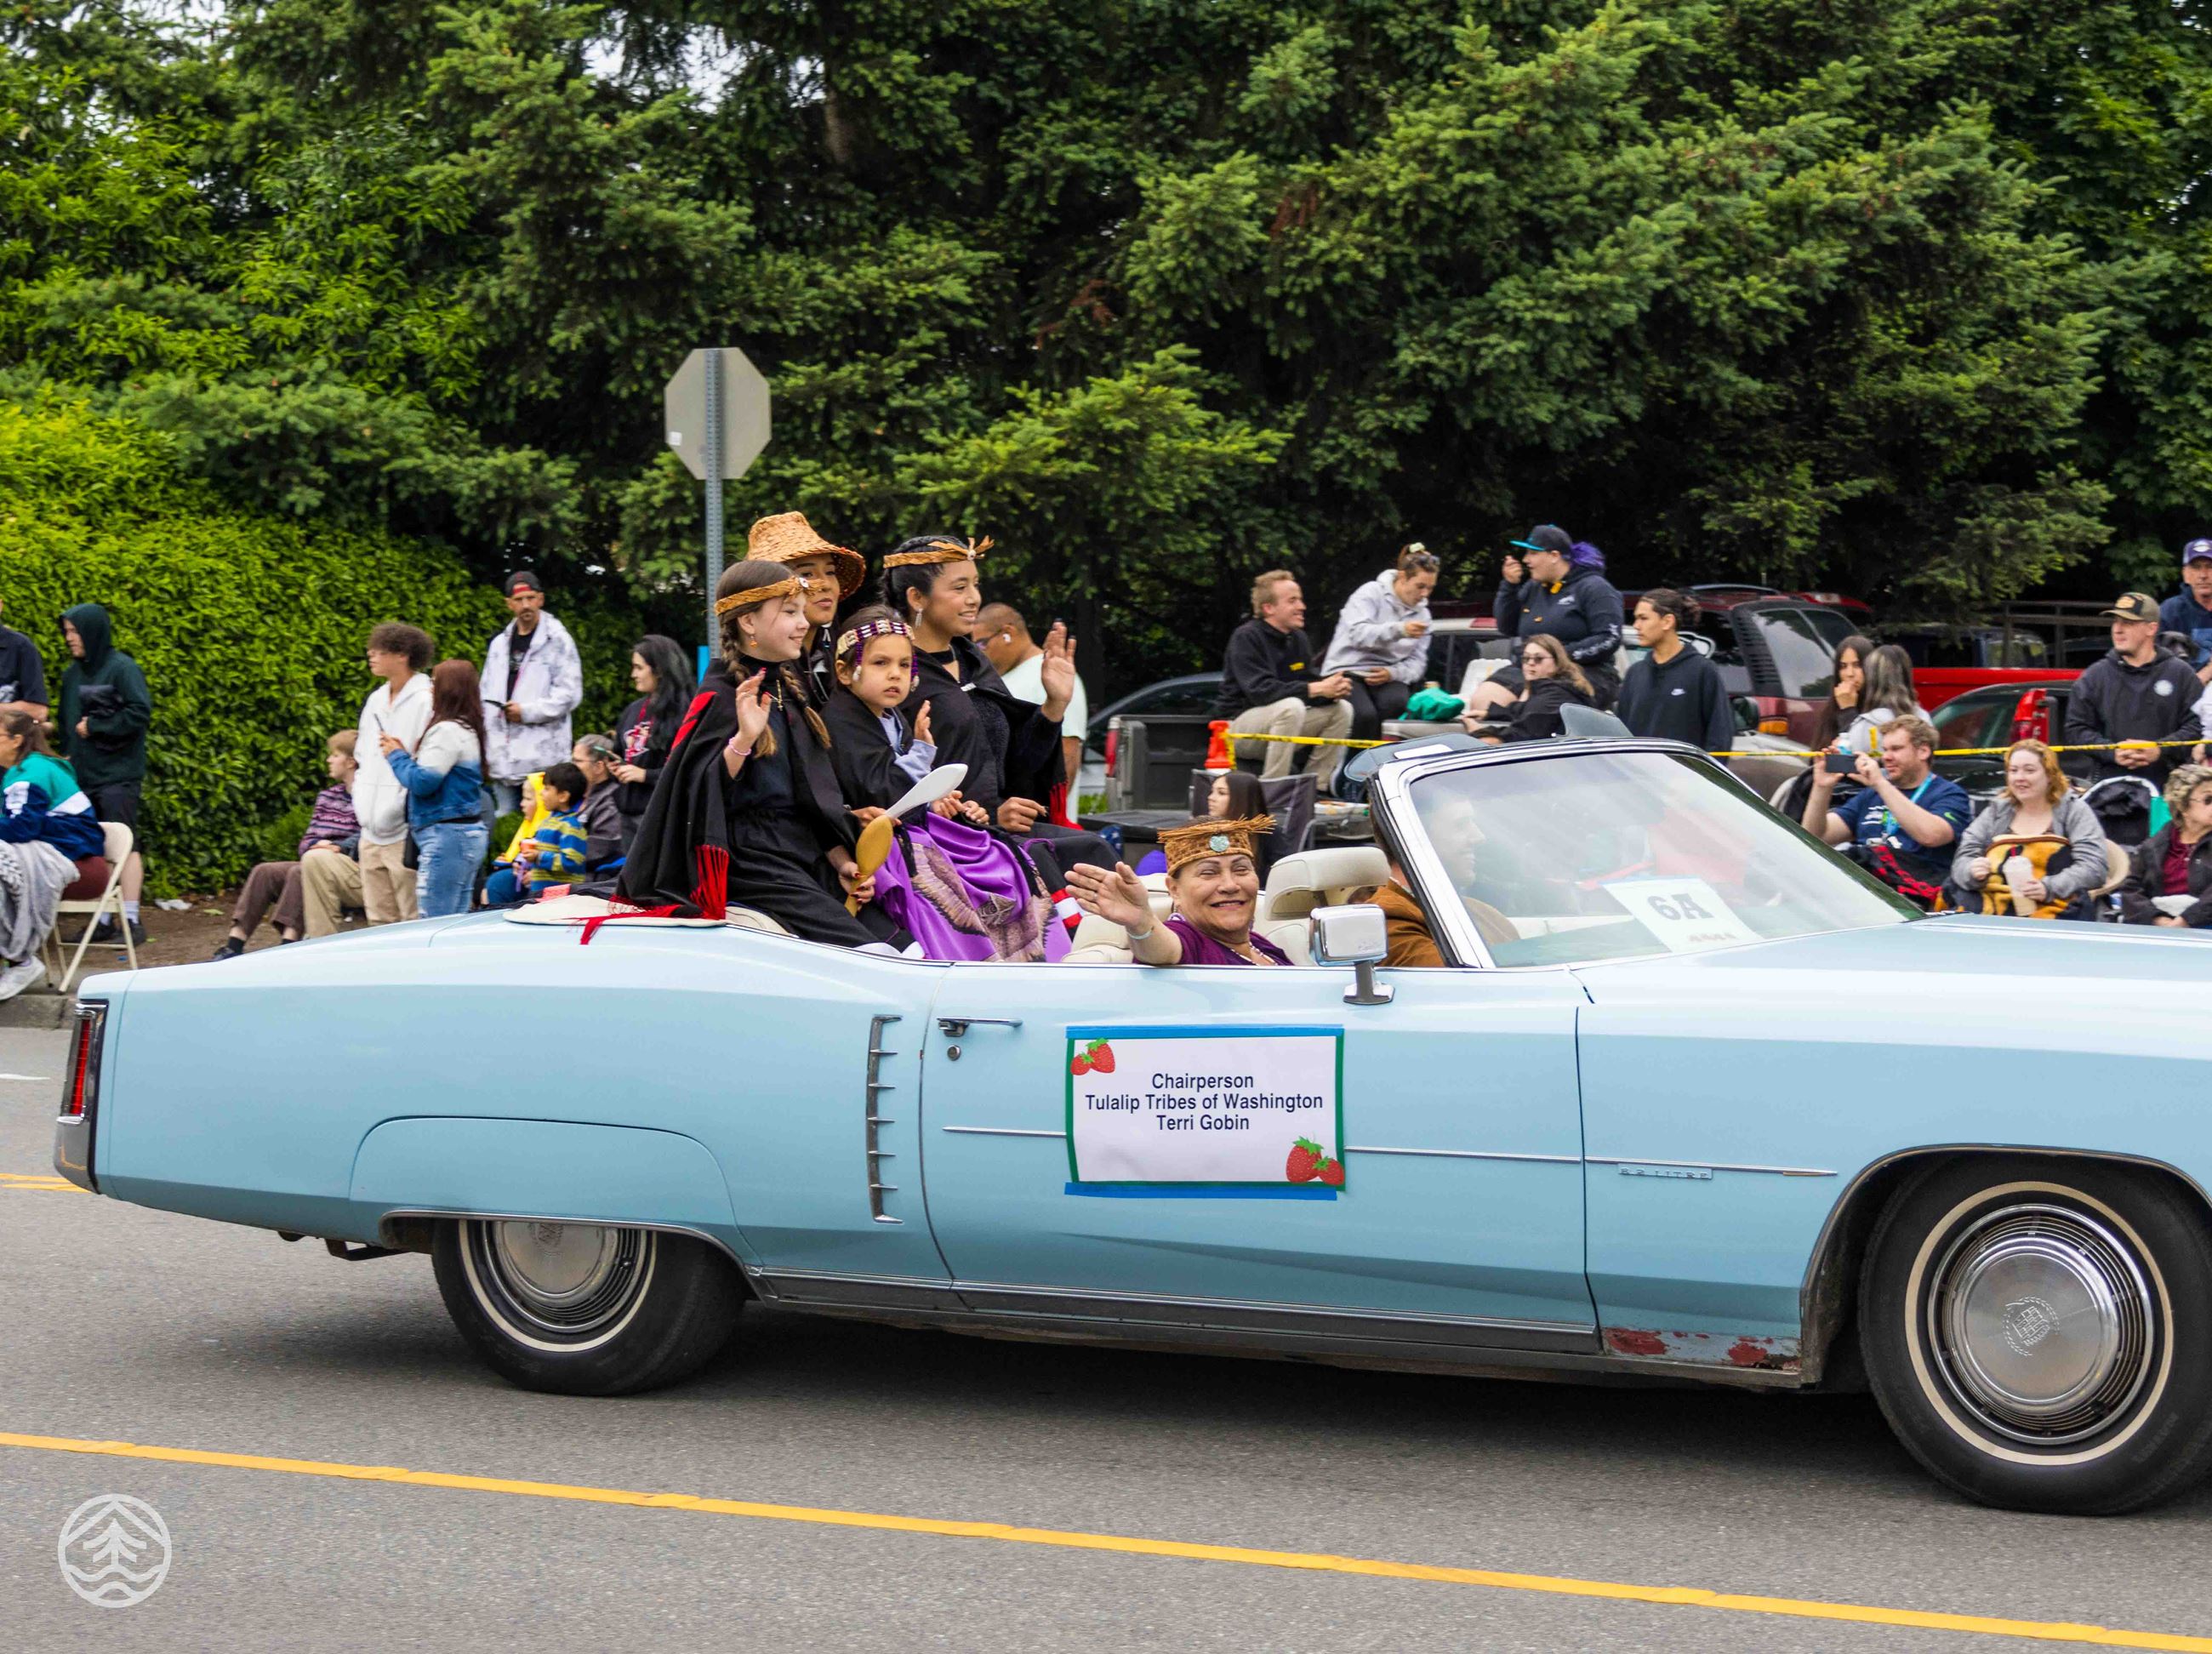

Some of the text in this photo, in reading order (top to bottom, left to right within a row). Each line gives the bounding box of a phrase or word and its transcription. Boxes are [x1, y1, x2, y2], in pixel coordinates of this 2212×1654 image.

[1648, 893, 1713, 920] 6A
[1153, 1073, 1253, 1092] Chairperson
[1086, 1093, 1322, 1114] Tulalip Tribes of Washington
[1156, 1115, 1249, 1130] Terri Gobin
